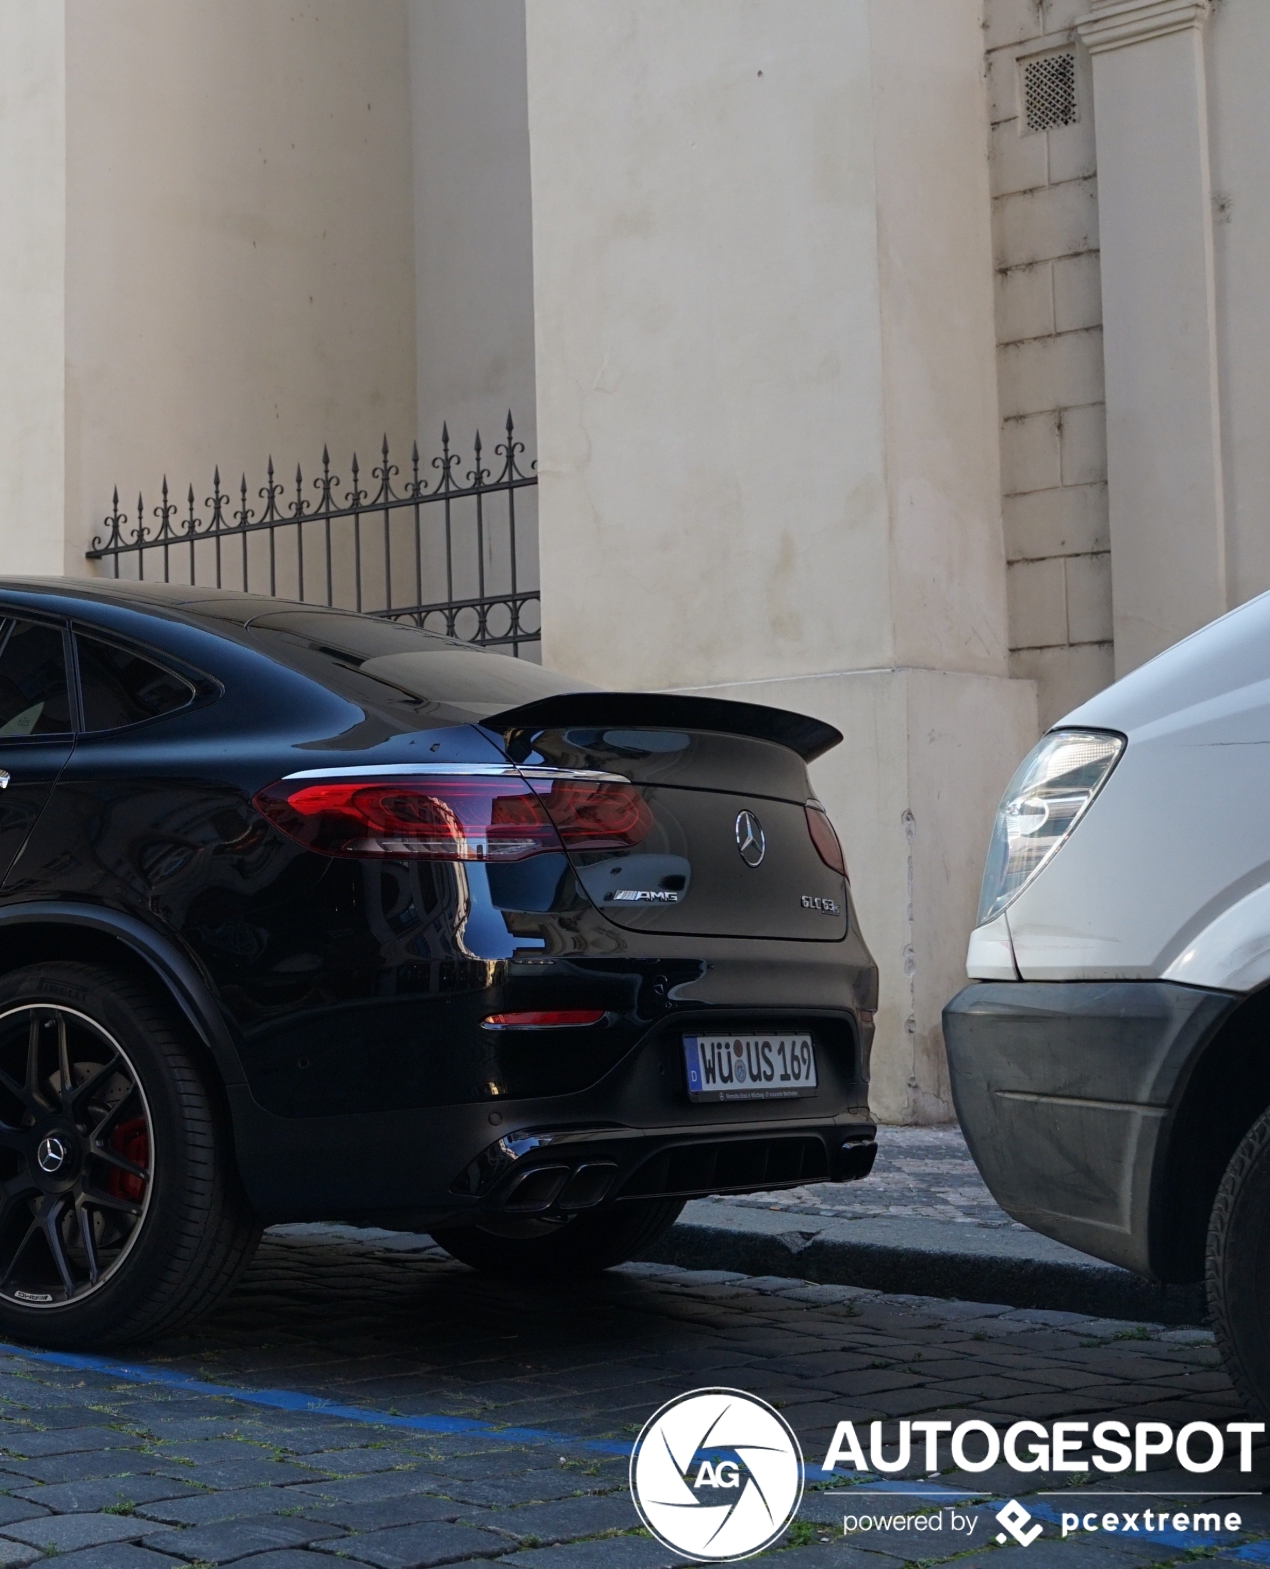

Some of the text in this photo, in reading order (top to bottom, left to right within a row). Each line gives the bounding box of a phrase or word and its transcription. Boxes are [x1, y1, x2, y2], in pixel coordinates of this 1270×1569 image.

[634, 890, 678, 902] AMG
[700, 1040, 812, 1084] WÜ US 169
[691, 1070, 698, 1082] D
